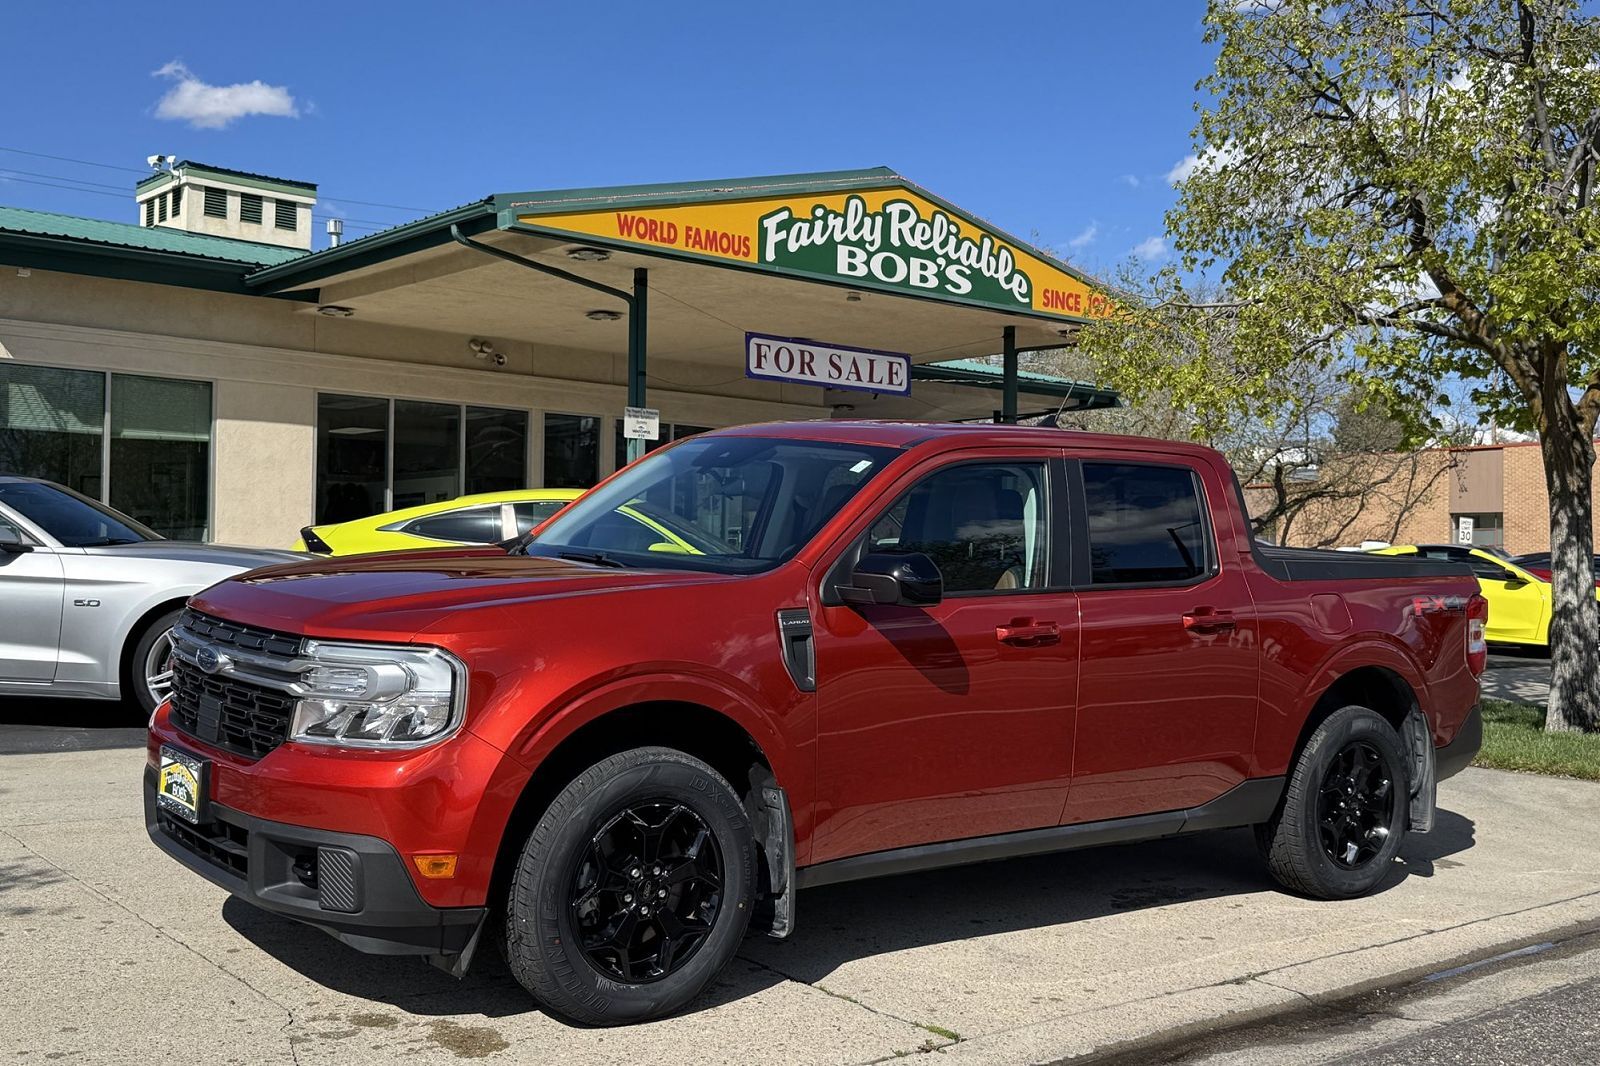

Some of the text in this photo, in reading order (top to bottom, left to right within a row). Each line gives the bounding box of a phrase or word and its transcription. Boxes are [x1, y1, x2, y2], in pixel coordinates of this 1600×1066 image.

[616, 213, 751, 258] WORLD FAMOUS
[763, 198, 1029, 303] Fairly Reliable
[837, 245, 972, 295] BOB'S
[1042, 288, 1082, 312] SINCE
[754, 343, 903, 386] FOR SALE
[1460, 531, 1471, 541] 30
[74, 599, 101, 607] 5.0
[1413, 596, 1465, 617] FX4
